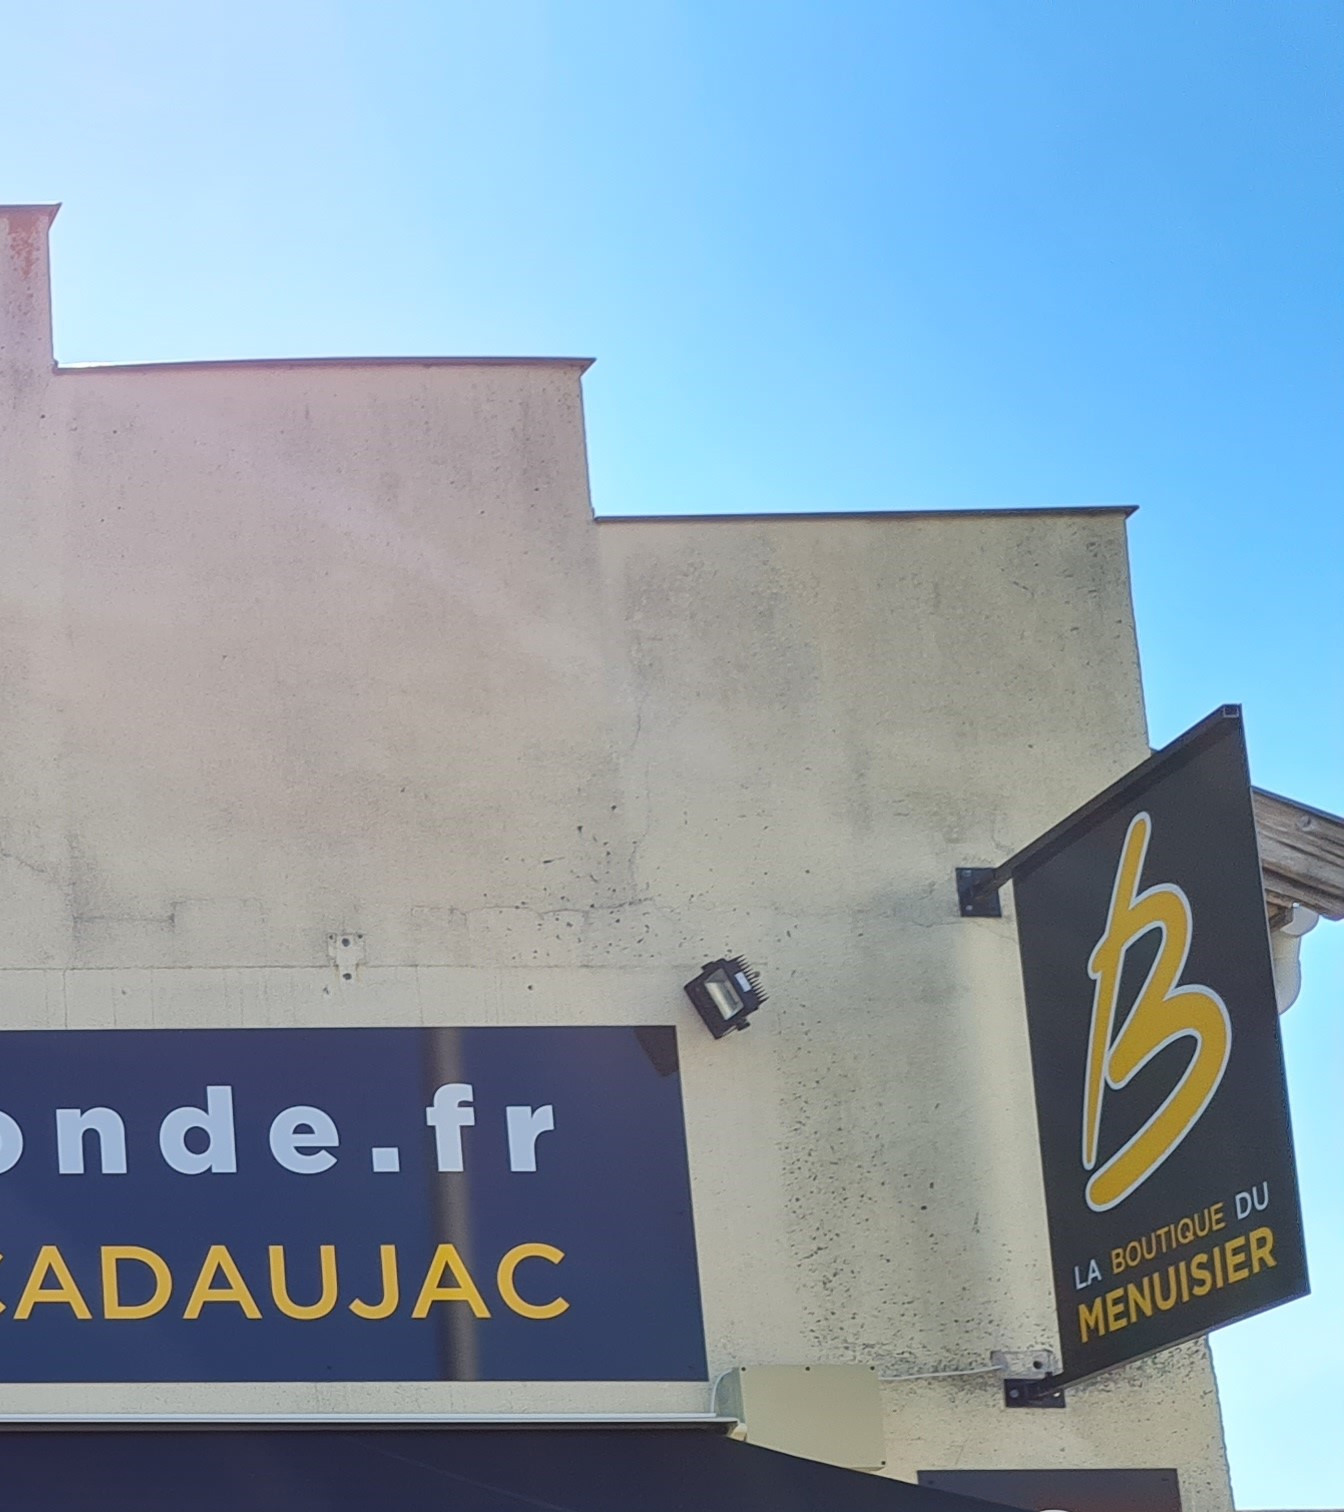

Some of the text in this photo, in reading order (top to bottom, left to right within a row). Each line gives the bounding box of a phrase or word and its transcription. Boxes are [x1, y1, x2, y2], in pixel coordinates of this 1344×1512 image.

[1074, 1181, 1269, 1290] LA BOUTIQUE DU
[1077, 1225, 1276, 1344] MENUISIER
